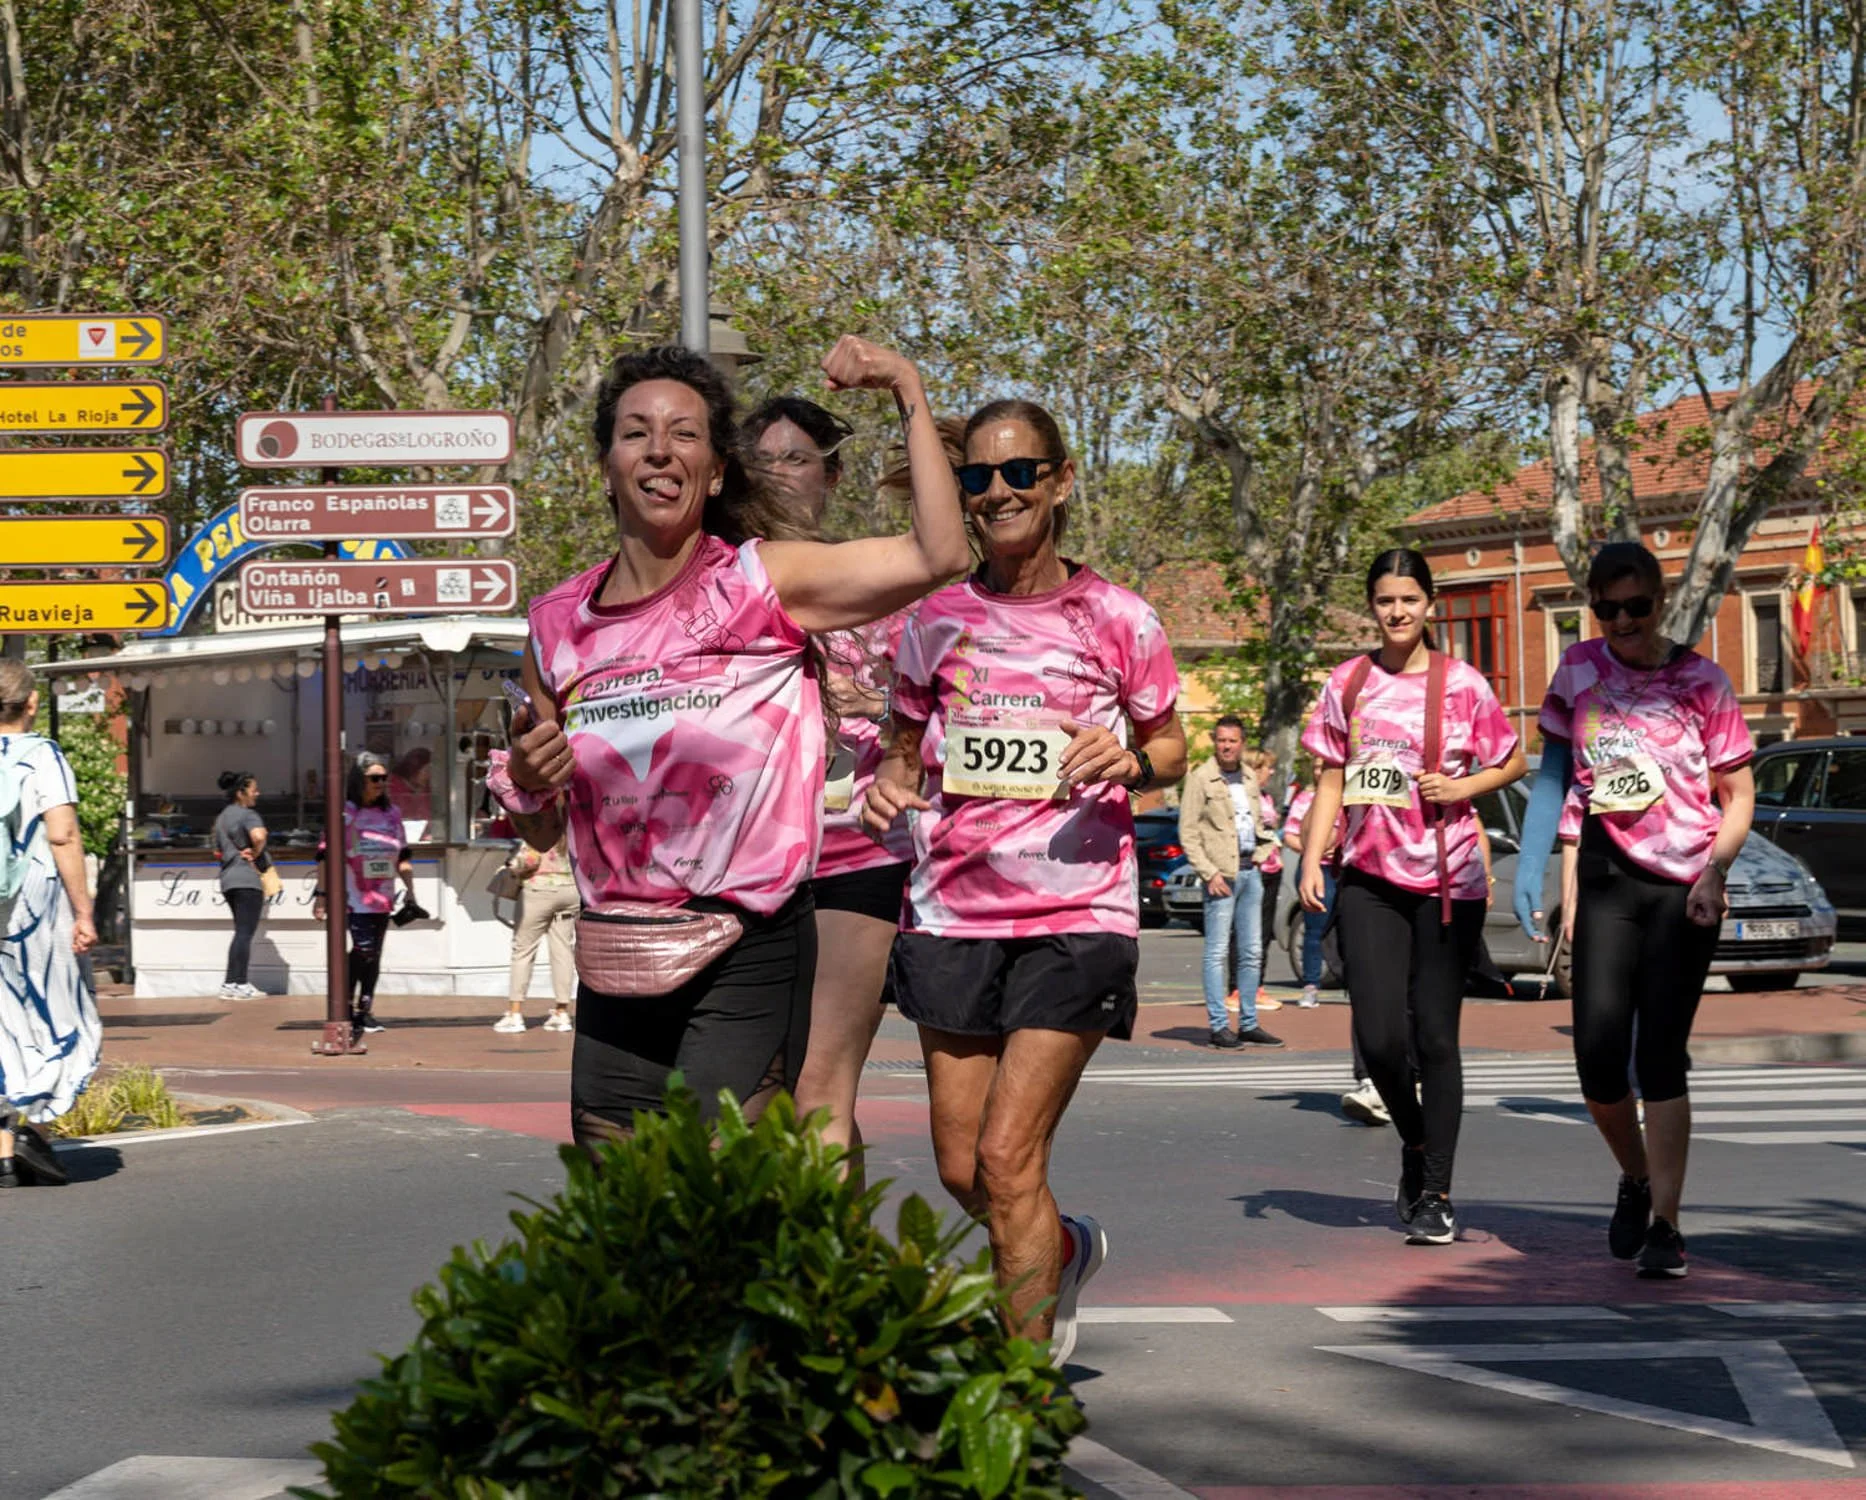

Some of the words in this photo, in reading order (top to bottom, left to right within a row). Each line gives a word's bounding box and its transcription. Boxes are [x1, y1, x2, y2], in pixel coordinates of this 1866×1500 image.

[2, 323, 27, 338] de
[49, 410, 66, 423] La
[77, 410, 119, 425] Rioja
[407, 427, 497, 448] LOGROÑO
[247, 496, 315, 512] Franco
[326, 494, 428, 514] Españolas
[248, 515, 311, 532] Olarra
[250, 568, 340, 586] Ontañón
[249, 588, 296, 606] Viña
[308, 587, 368, 608] Ijalba
[0, 604, 93, 624] Ruavieja
[971, 666, 989, 683] XI
[968, 689, 1042, 708] Carrera
[1360, 734, 1409, 750] Carrera
[963, 735, 1049, 774] 5923
[1357, 767, 1402, 791] 1879
[157, 870, 201, 906] La
